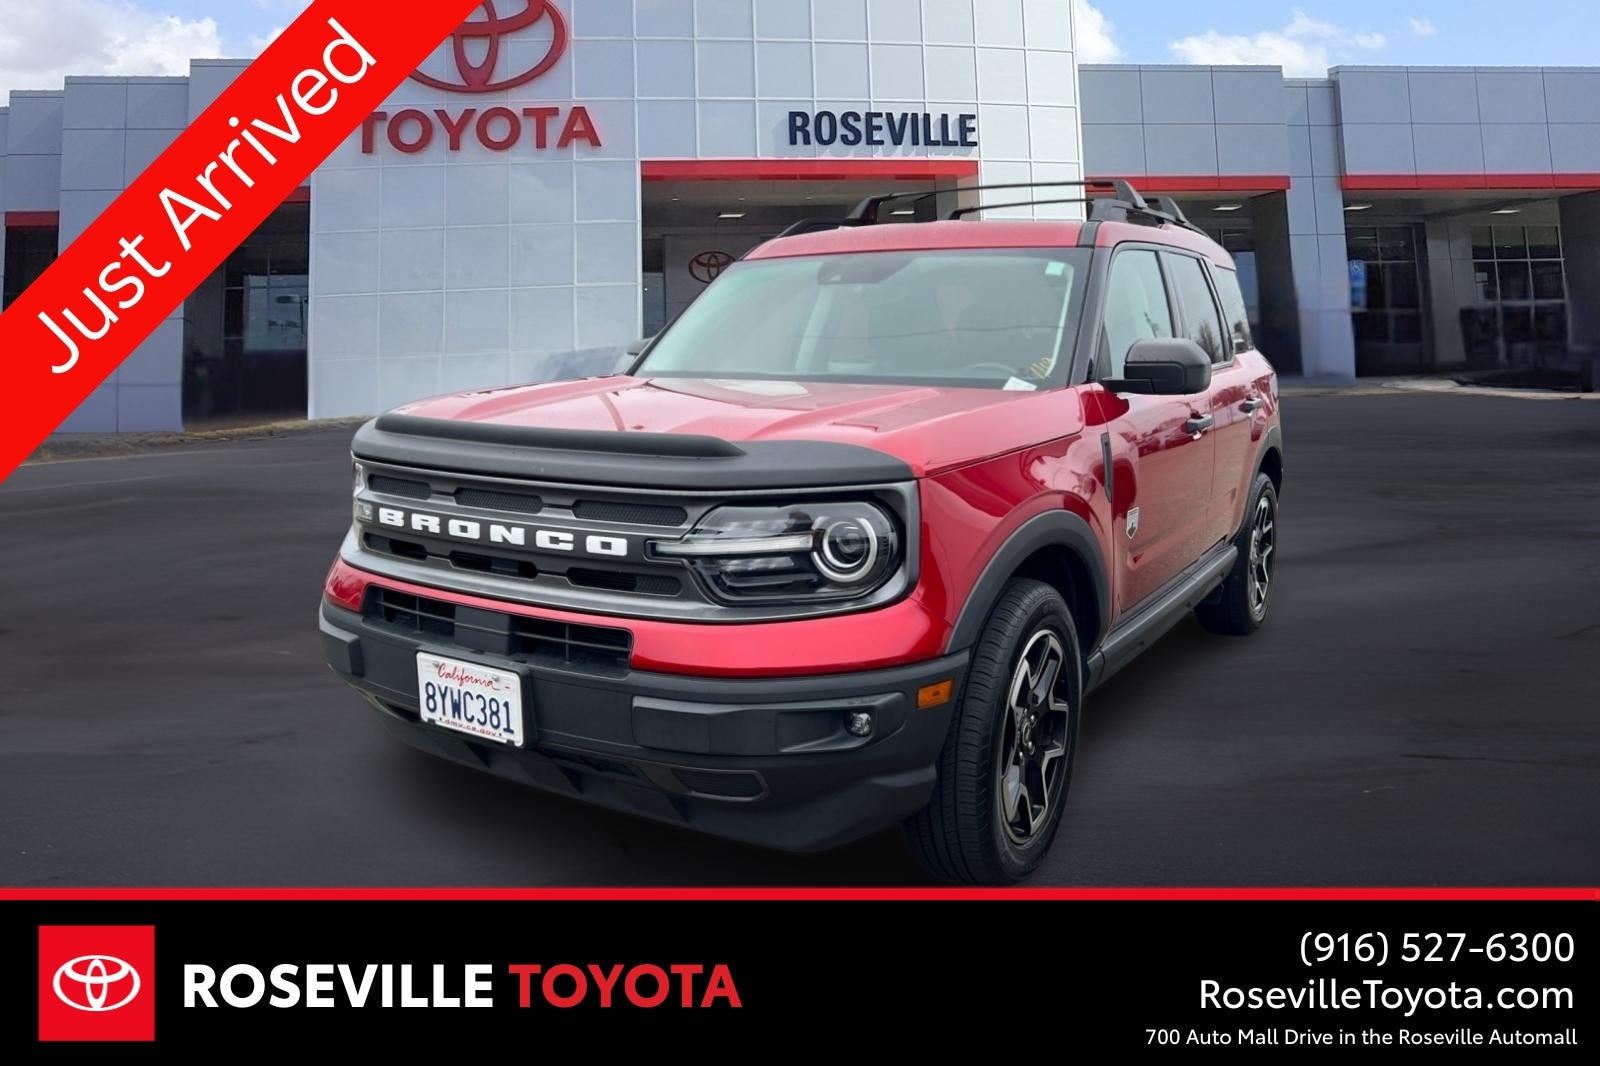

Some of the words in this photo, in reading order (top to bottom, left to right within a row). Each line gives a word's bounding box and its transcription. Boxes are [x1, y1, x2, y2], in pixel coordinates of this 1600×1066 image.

[361, 106, 602, 154] TOYOTA
[787, 110, 978, 147] ROSEVILLE
[378, 506, 628, 558] BRONCO
[437, 662, 500, 690] California
[425, 681, 515, 734] 8YWC381
